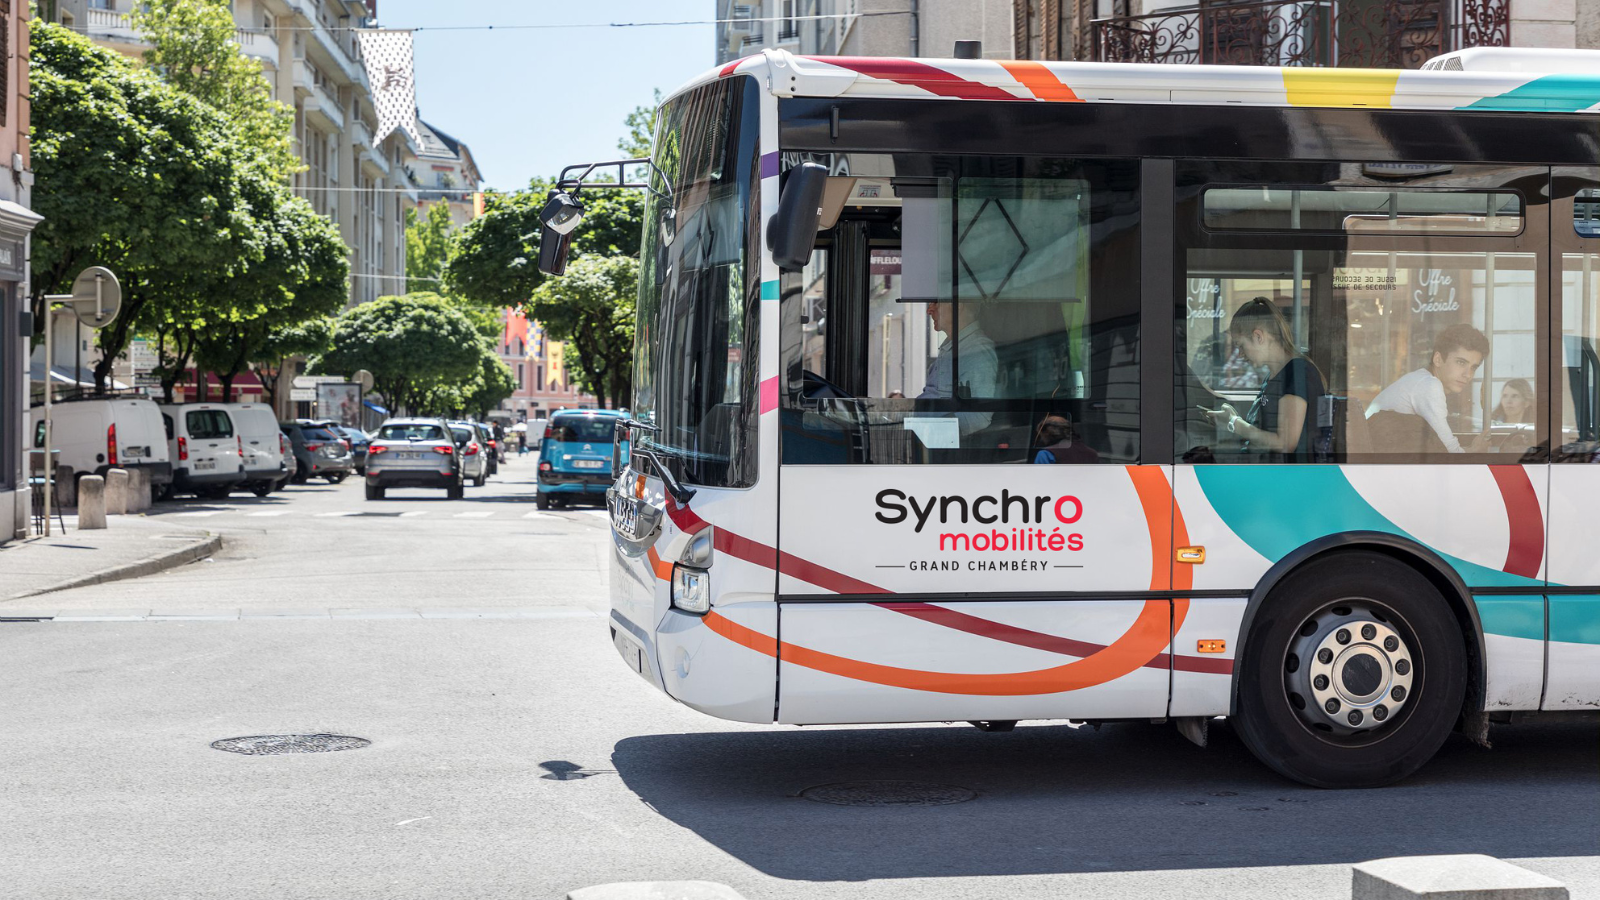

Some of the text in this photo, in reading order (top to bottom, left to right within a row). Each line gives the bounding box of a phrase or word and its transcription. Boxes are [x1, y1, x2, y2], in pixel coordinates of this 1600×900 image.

[1411, 287, 1460, 322] Spéciale
[875, 488, 1083, 533] Synchro
[939, 526, 1084, 551] mobilités
[909, 558, 1048, 571] GRAND CHAMBÉRY
